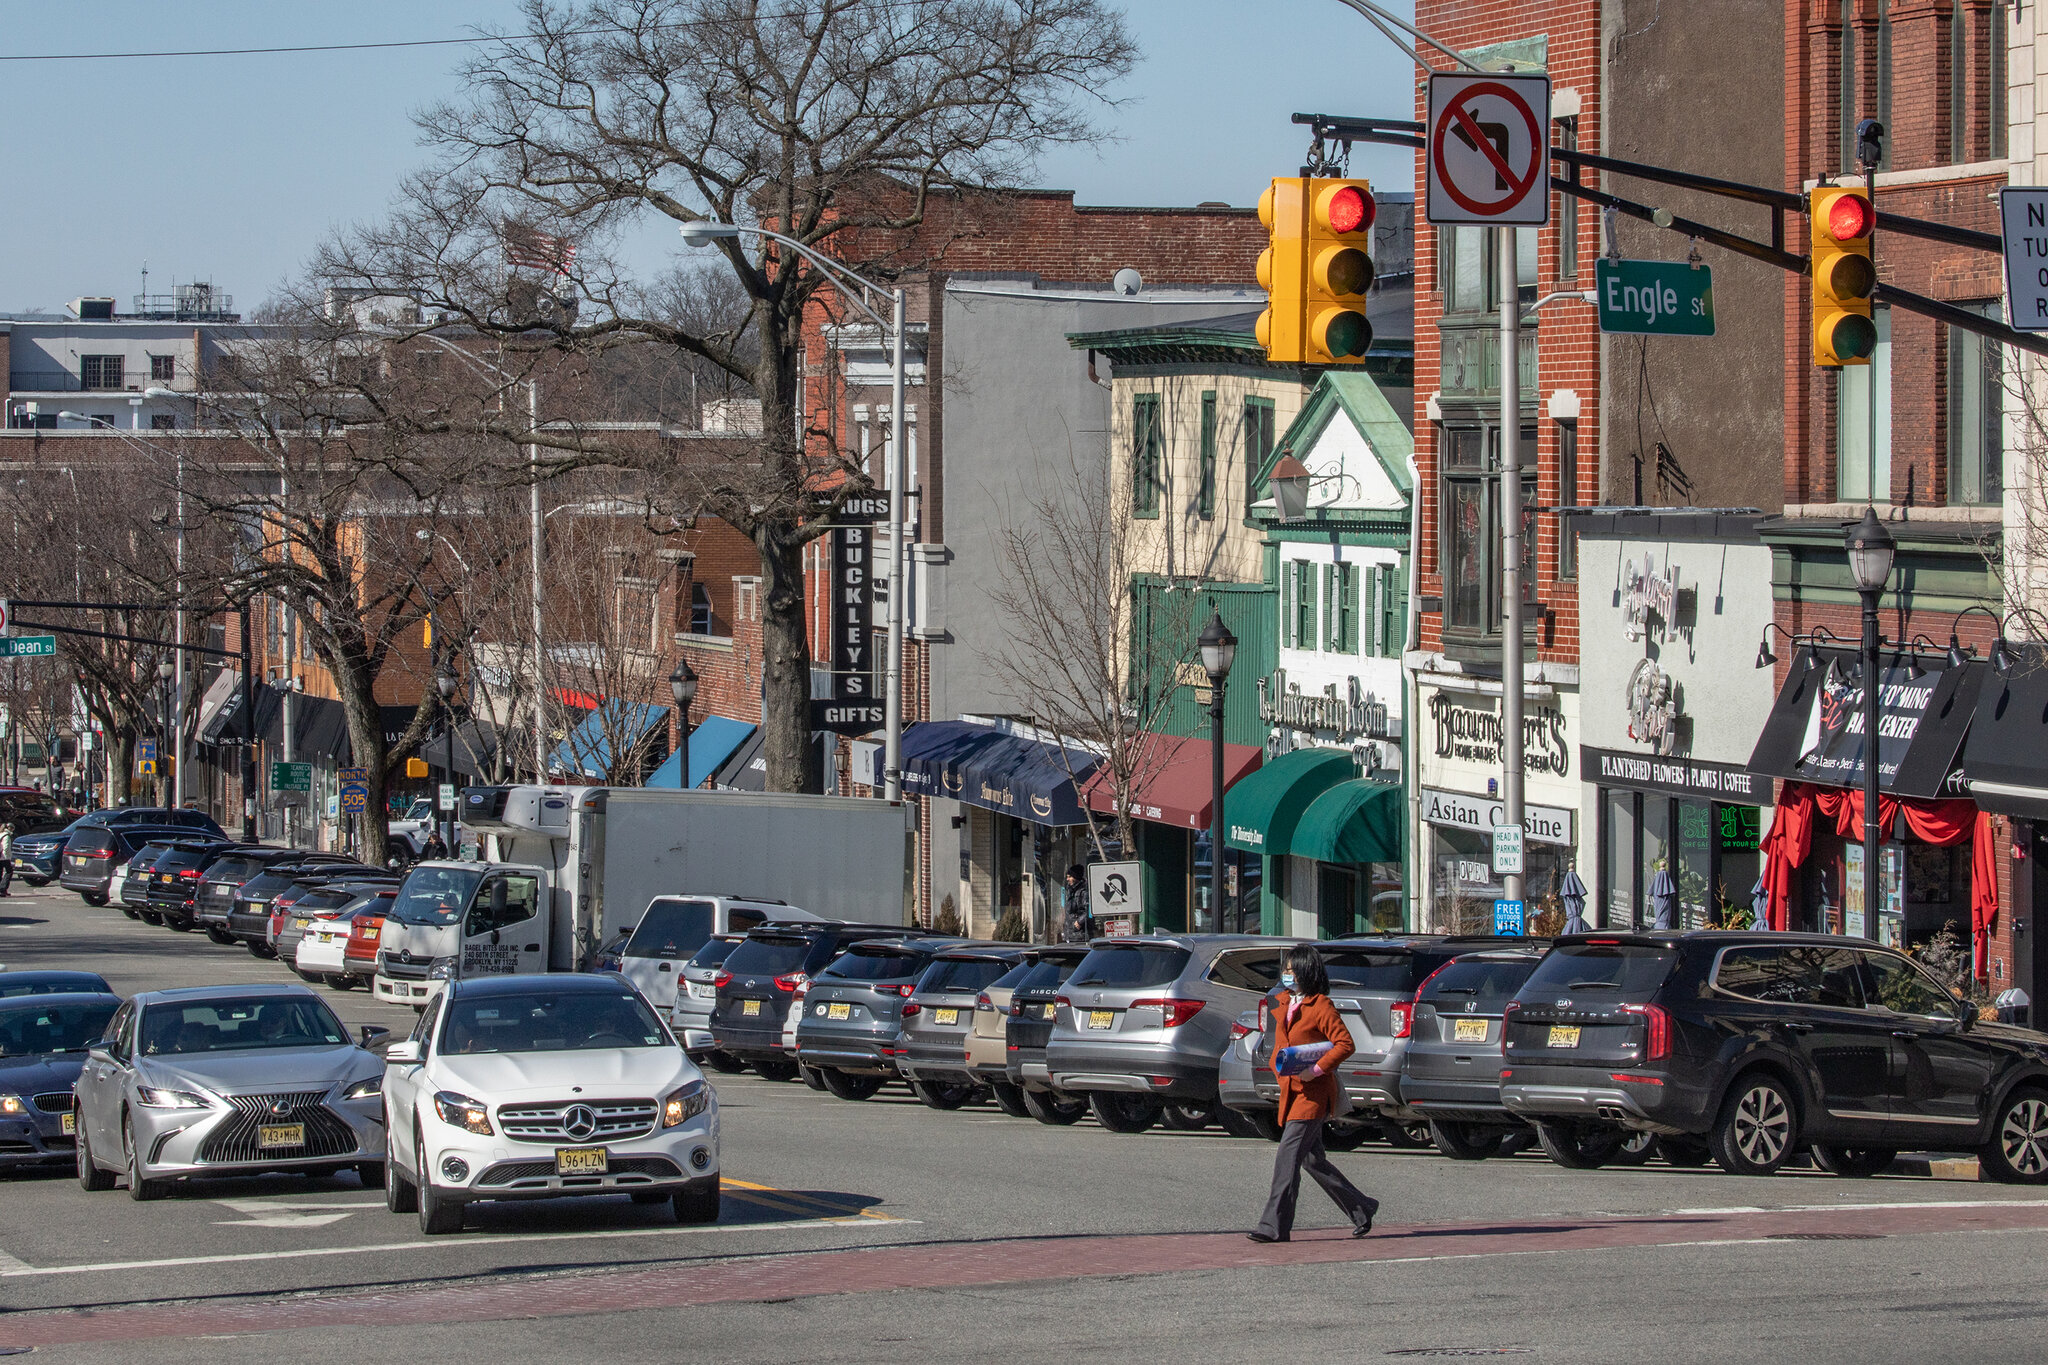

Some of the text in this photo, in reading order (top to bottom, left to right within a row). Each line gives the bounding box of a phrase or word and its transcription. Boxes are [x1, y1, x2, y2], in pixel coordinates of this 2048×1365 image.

[1606, 276, 1706, 325] Engle St
[819, 499, 889, 514] UGS
[846, 528, 862, 694] BUCKLEY'S
[9, 640, 42, 654] Dean
[45, 645, 53, 653] St
[825, 707, 883, 723] GIFTS
[1879, 714, 1919, 739] CENTER
[340, 771, 368, 780] NORTH
[1601, 756, 1751, 793] PLANTSHED FLOWERS PLANTS COFFEE
[343, 794, 366, 806] 505
[1429, 796, 1562, 838] Asian Csine
[1496, 831, 1520, 841] HEAD IN
[1496, 845, 1520, 854] PARKING
[1460, 861, 1488, 882] OPEN
[1496, 904, 1521, 914] FREE
[464, 944, 481, 952] BAGEL
[482, 944, 497, 952] BITES
